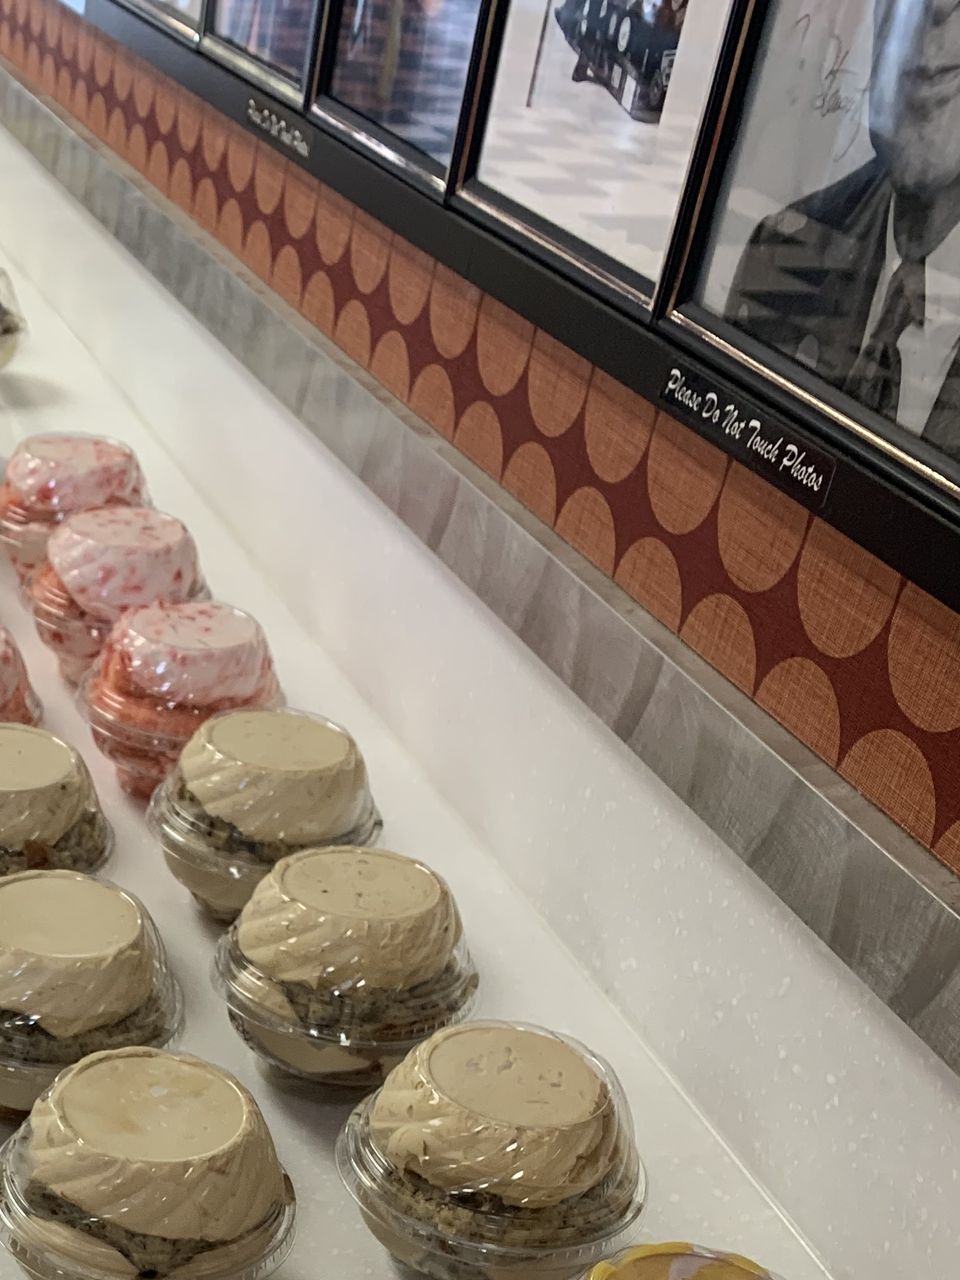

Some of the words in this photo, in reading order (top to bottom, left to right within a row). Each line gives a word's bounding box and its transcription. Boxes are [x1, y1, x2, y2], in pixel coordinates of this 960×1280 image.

[664, 368, 702, 410] Please
[702, 392, 720, 423] Do
[722, 404, 746, 439] Not
[746, 419, 784, 463] Touch
[779, 443, 824, 491] Photos
